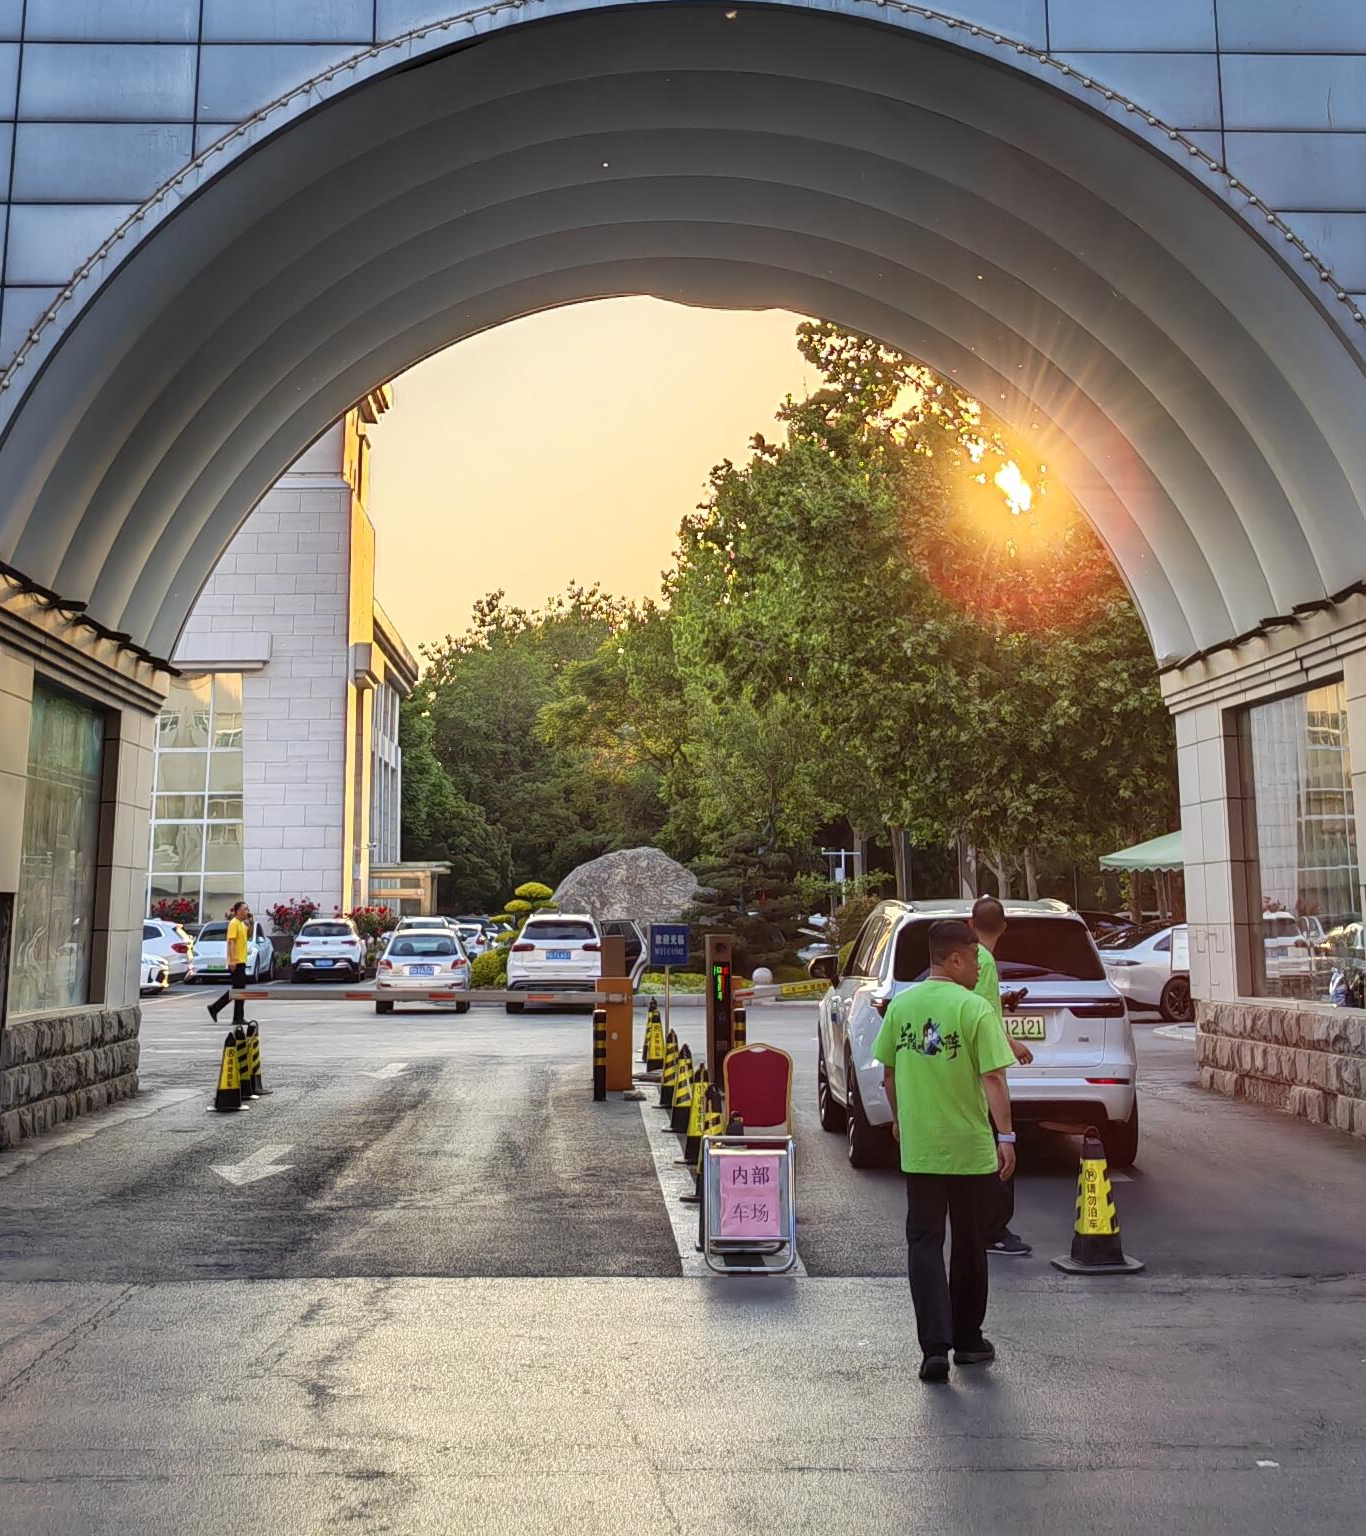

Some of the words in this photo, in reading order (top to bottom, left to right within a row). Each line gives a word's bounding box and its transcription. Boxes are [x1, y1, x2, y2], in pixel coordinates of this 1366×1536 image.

[731, 1165, 770, 1186] 内部
[730, 1203, 770, 1224] 车场
[1086, 1183, 1099, 1230] 请勿泊车
